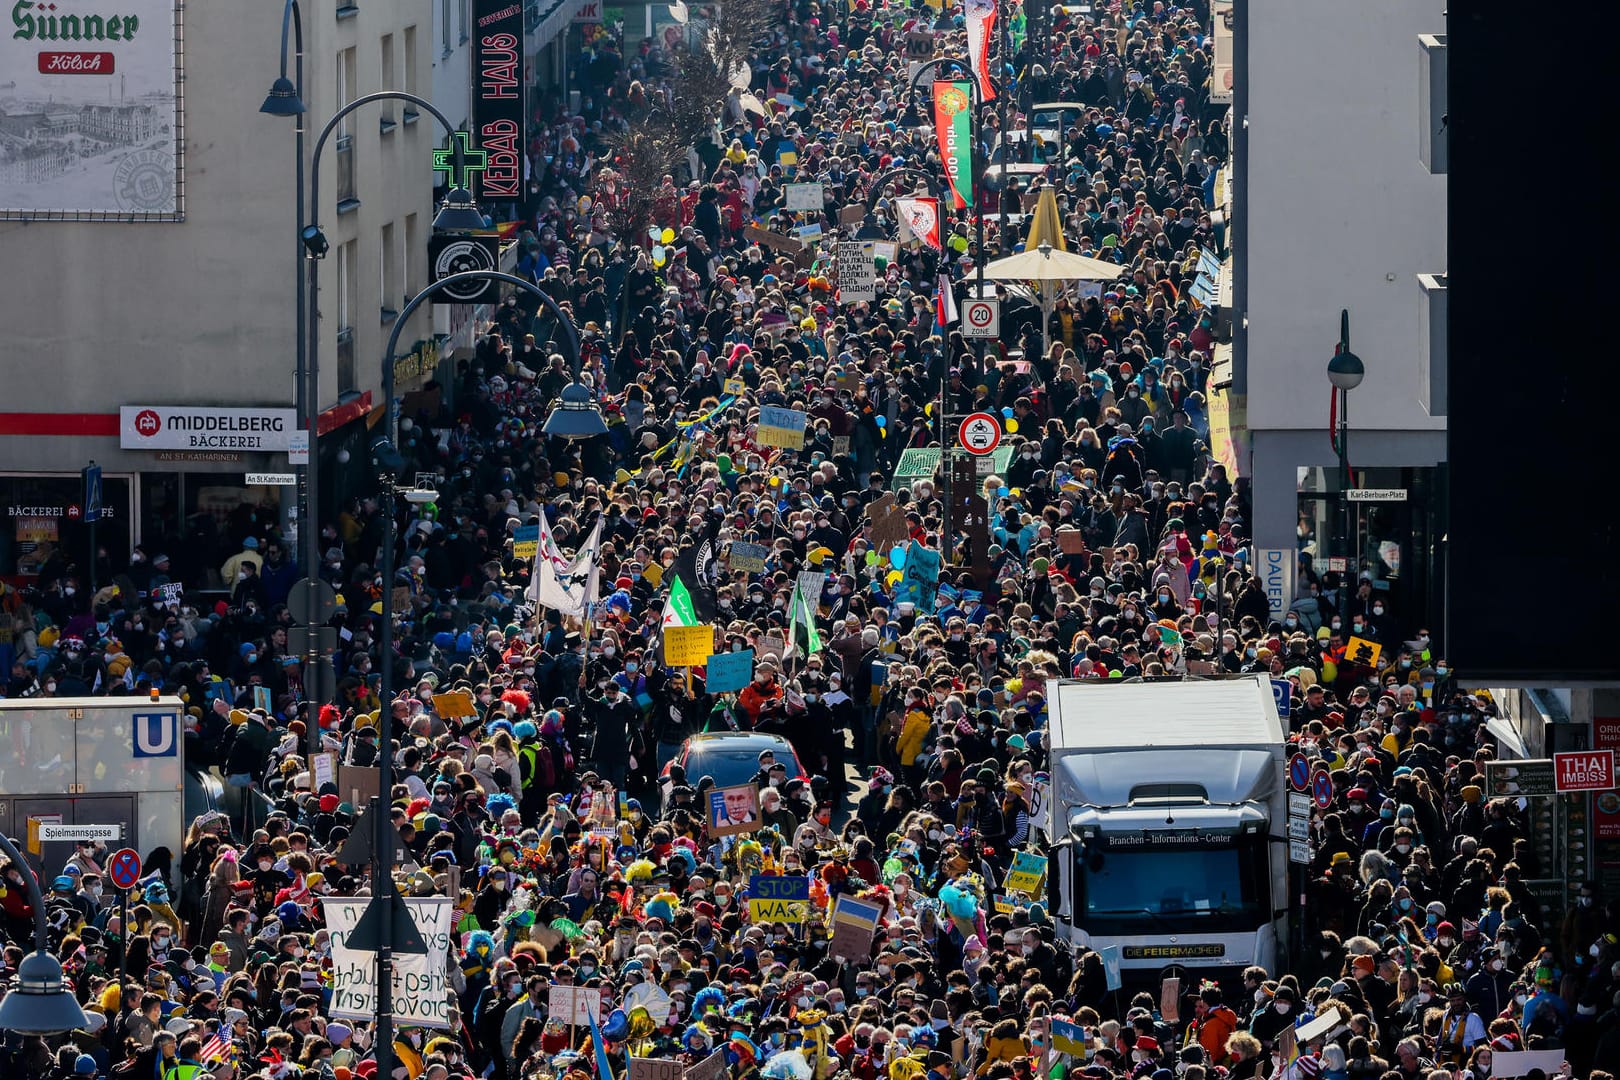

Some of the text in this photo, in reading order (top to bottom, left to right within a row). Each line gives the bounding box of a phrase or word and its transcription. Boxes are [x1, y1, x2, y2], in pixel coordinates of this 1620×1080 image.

[12, 0, 139, 41] Sünner
[48, 54, 101, 70] Kölsch
[482, 33, 518, 98] HAUS
[482, 119, 519, 196] KEBAB
[840, 284, 874, 292] СТЫДНО!
[974, 309, 988, 321] 20
[167, 415, 283, 432] MIDDELBERG
[190, 433, 261, 448] BÄCKEREI
[160, 453, 172, 461] AN
[188, 454, 238, 462] KATHARINEN
[247, 475, 256, 483] An
[1350, 490, 1405, 499] Karl-Berbuer-Platz
[8, 504, 114, 517] BÄCKEREI FÉ
[137, 716, 173, 754] U
[1562, 756, 1607, 773] THAI
[1563, 771, 1607, 783] IMBISS
[45, 827, 112, 840] Spielmannsgasse
[1109, 836, 1144, 845] Branchen
[1151, 834, 1199, 844] Informations
[1205, 834, 1231, 843] Center
[757, 879, 804, 896] STOP
[1126, 945, 1222, 957] DIE FEIERMACHER
[636, 1061, 681, 1080] STOP
